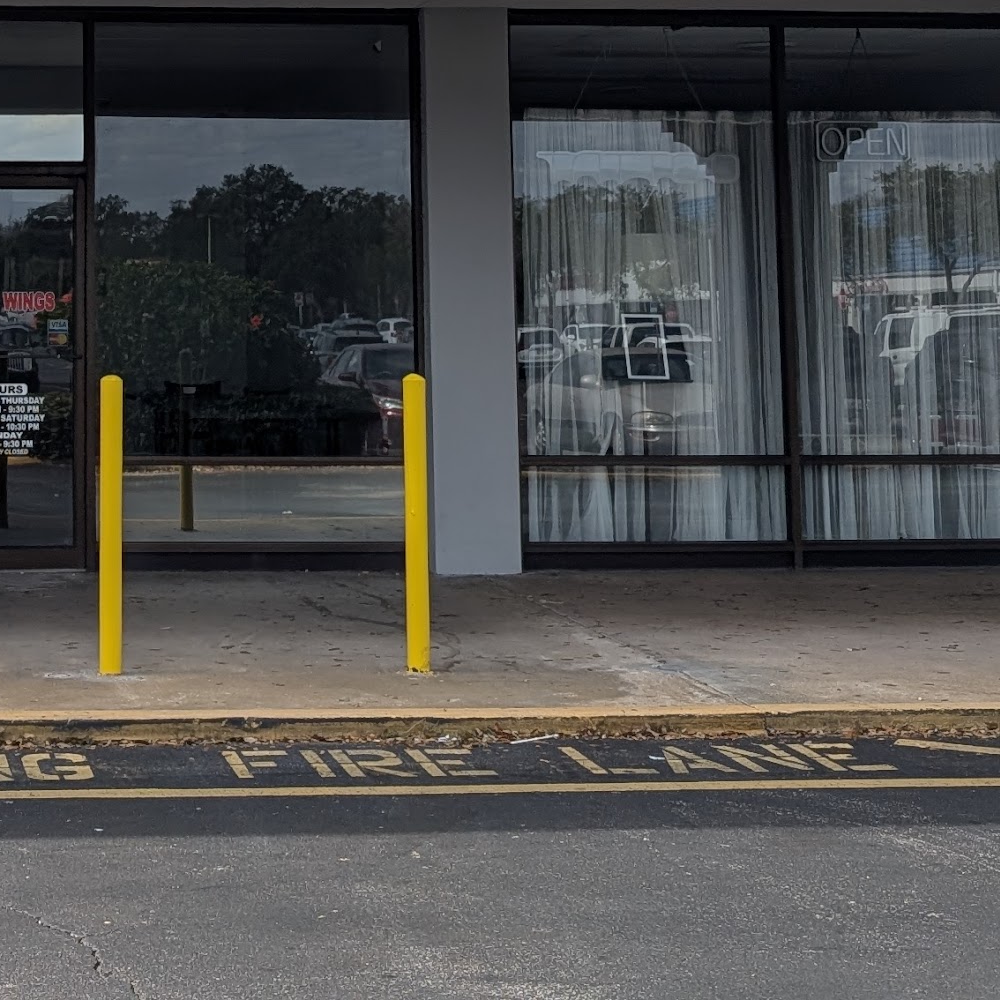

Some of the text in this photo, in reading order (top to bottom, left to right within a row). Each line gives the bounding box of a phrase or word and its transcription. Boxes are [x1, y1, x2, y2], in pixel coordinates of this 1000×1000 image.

[821, 127, 906, 156] OPEN
[2, 291, 56, 312] WINGS
[1, 397, 45, 405] THURSDAY
[8, 405, 25, 413] 9:30
[27, 405, 40, 413] PM
[0, 414, 45, 422] SATURDAY
[6, 423, 26, 431] 10:30
[28, 423, 40, 431] PM
[3, 440, 20, 448] 9:30
[21, 440, 33, 448] PM
[221, 747, 500, 780] FIRE
[557, 742, 900, 776] LANE
